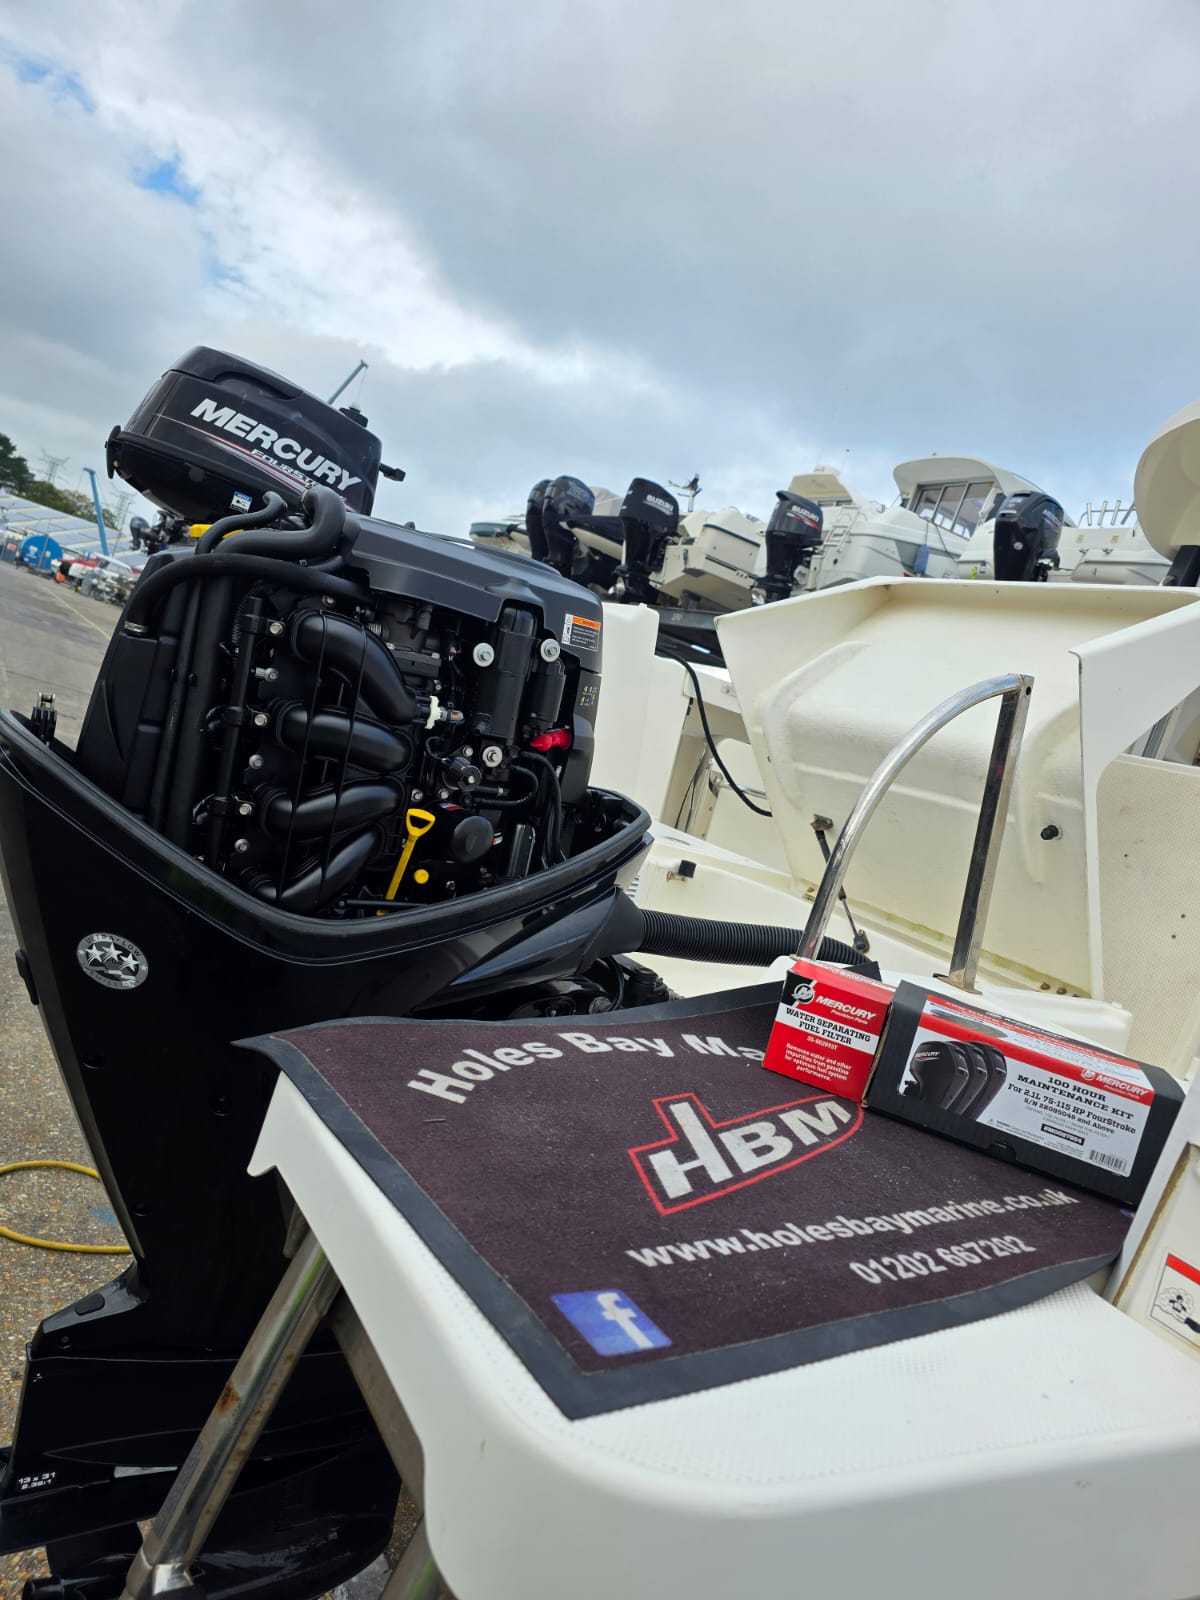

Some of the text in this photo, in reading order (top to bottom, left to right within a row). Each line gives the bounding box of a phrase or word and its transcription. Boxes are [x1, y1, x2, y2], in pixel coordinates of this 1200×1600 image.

[190, 398, 362, 491] MERCURY
[251, 448, 321, 488] FOURSTR
[646, 494, 674, 512] SUZUKI
[791, 505, 819, 522] SUZUKI
[121, 940, 141, 957] LOW
[815, 995, 877, 1020] MERCURY
[786, 1007, 871, 1042] WATER SEPARATING
[799, 1021, 852, 1045] FUEL FILTER
[407, 1041, 564, 1104] Holes
[558, 1032, 675, 1058] Bay
[786, 1043, 852, 1070] Removes water and other
[786, 1048, 849, 1075] impurities from gasoline
[793, 1058, 817, 1070] optimum
[816, 1065, 828, 1074] fuel
[827, 1069, 848, 1081] system
[796, 1065, 831, 1081] performance.
[1096, 1075, 1149, 1096] MERCURY
[1017, 1075, 1134, 1120] MAINTENANCE KIT
[1048, 1077, 1106, 1102] 100 HOUR
[1008, 1083, 1023, 1094] For
[1023, 1089, 1041, 1101] 2.1L
[1043, 1095, 1071, 1111] 75-115
[1072, 1105, 1086, 1115] HP
[1087, 1111, 1137, 1134] FourStroke
[1024, 1097, 1038, 1107] S/N
[1077, 1117, 1091, 1126] and
[1092, 1122, 1115, 1134] Above
[648, 1100, 852, 1199] HBM
[627, 1189, 1079, 1268] www.holesbaymarine.co.uk
[849, 1235, 1037, 1285] 01202 667202
[19, 1476, 31, 1484] 13
[42, 1471, 56, 1480] 31
